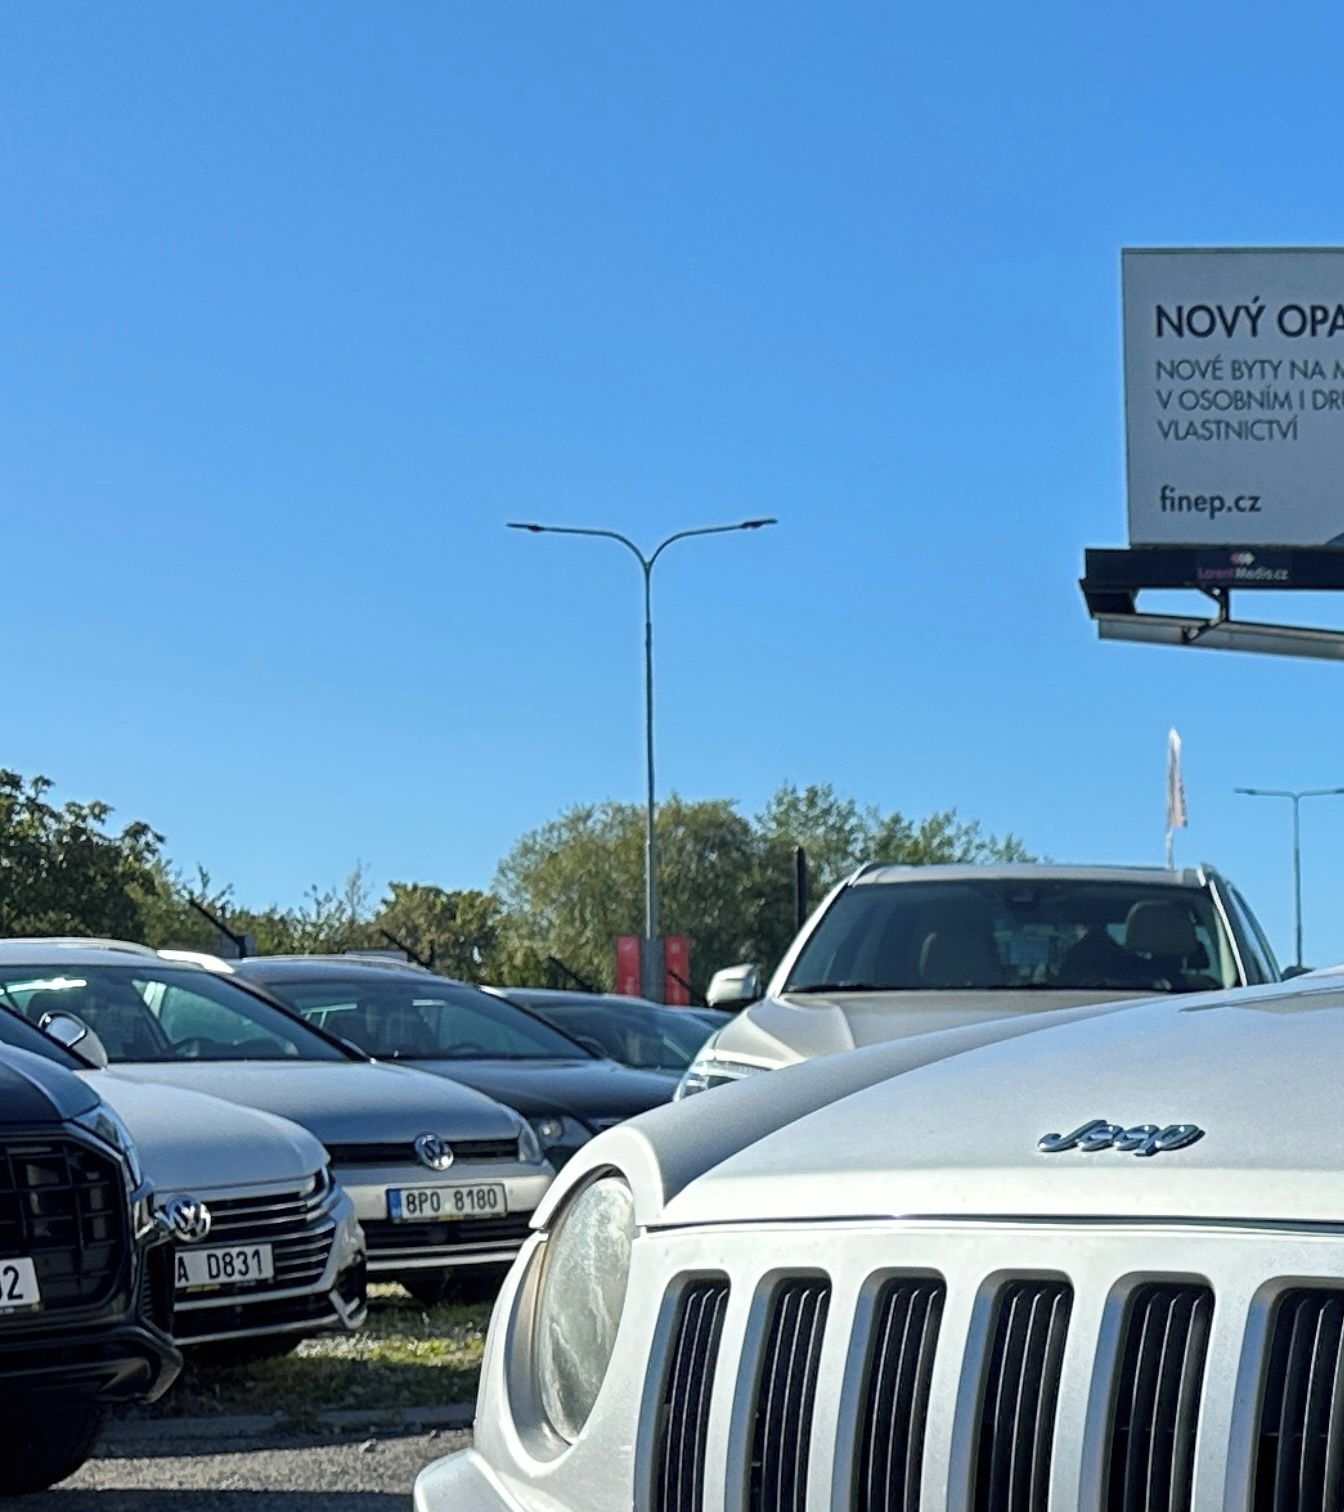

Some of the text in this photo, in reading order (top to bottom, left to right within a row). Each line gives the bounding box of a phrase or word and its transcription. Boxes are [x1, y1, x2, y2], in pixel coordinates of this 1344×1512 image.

[1156, 296, 1267, 338] NOVÝ
[1156, 354, 1224, 381] NOVÉ
[1230, 359, 1283, 381] BYTY
[1289, 359, 1327, 381] NA
[1156, 389, 1174, 411] V
[1178, 385, 1293, 412] OSOBNÍM
[1299, 389, 1305, 411] I
[1156, 414, 1299, 441] VLASTNICTVÍ
[1160, 484, 1262, 520] finep.cz
[1037, 1119, 1201, 1157] Jeep
[454, 1188, 498, 1211] 8180
[207, 1249, 262, 1280] D831
